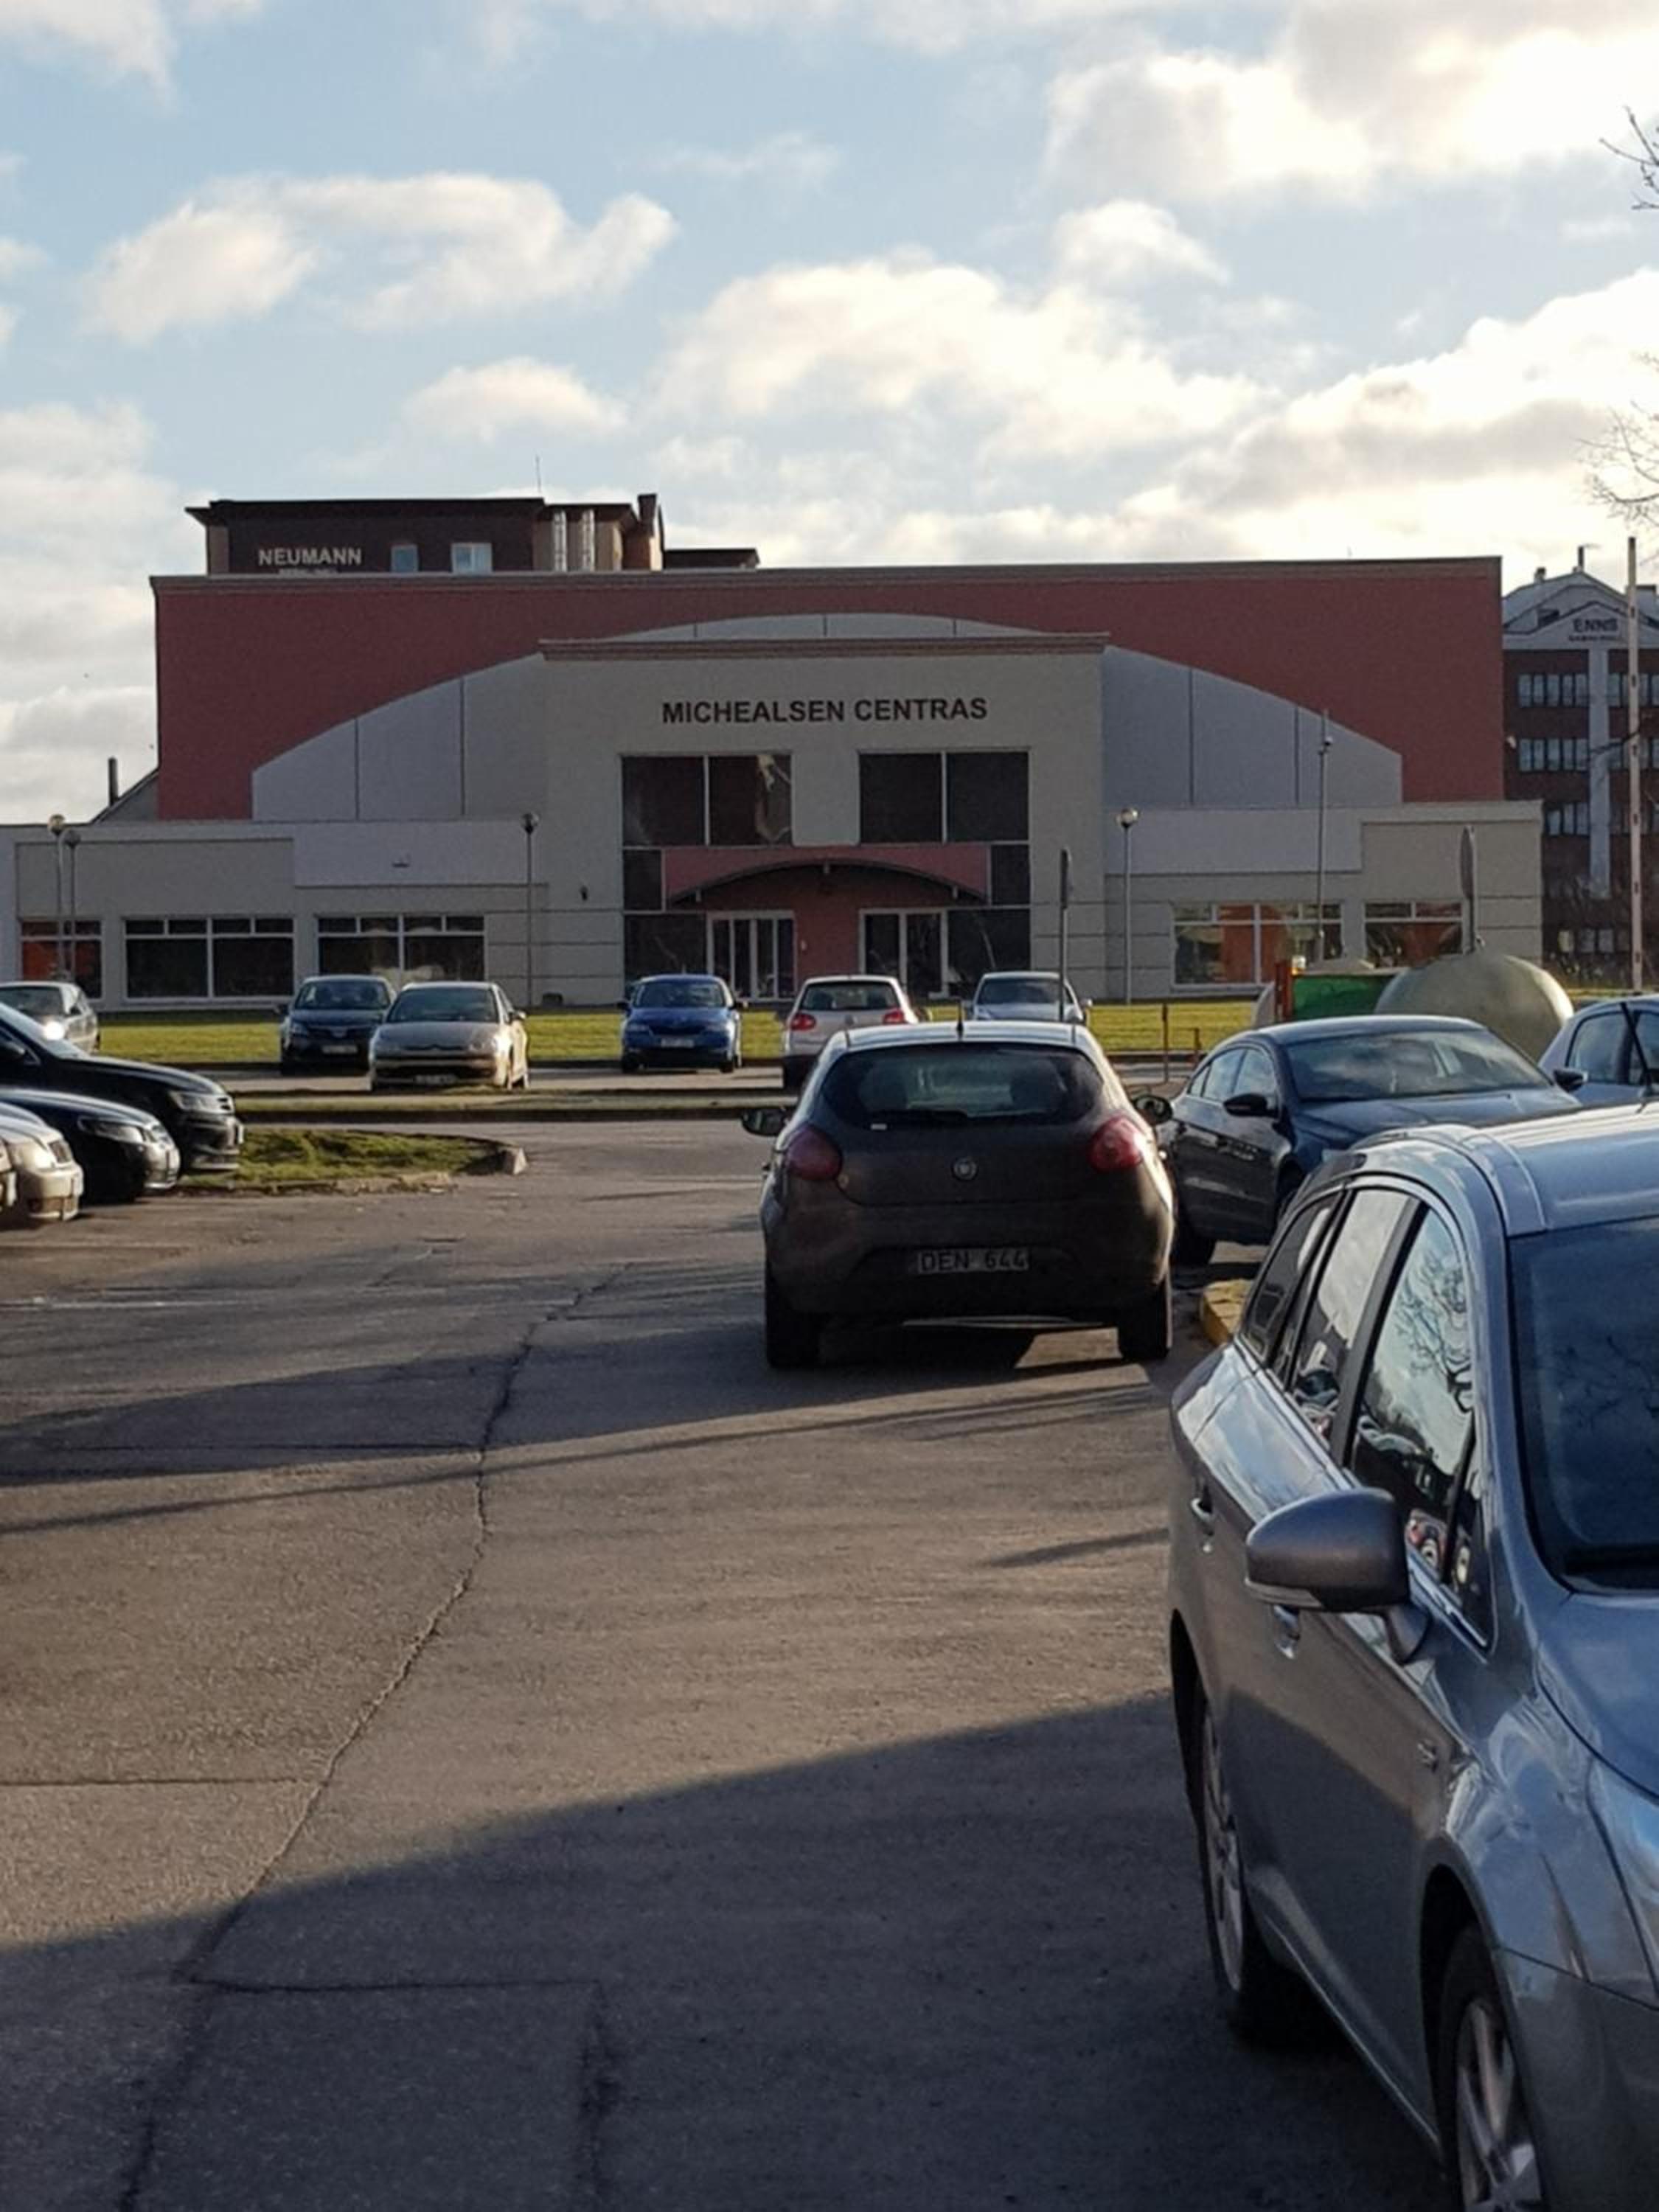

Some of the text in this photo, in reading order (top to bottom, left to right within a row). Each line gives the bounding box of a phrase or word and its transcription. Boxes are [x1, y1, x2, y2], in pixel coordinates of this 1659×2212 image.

[259, 547, 362, 566] NEUMANN
[662, 697, 988, 723] MICHEALSEN CENTRAS
